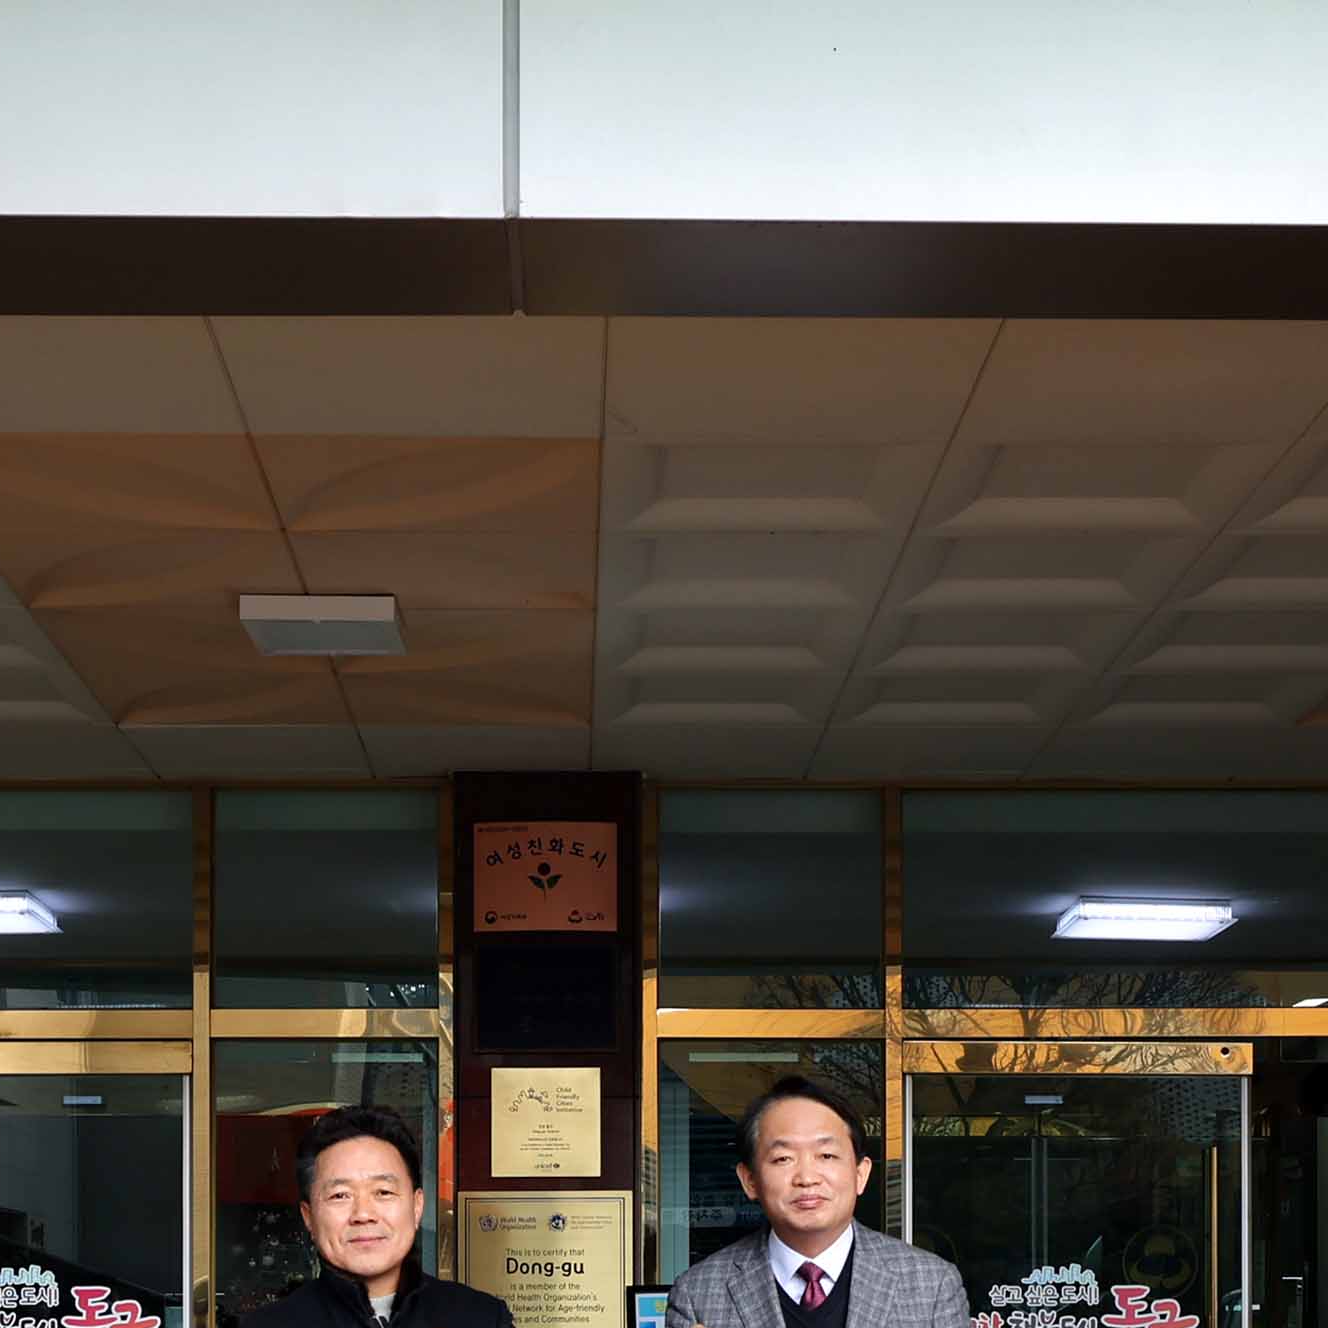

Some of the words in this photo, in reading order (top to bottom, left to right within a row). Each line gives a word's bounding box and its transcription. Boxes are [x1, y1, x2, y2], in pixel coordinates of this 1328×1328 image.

[486, 836, 608, 868] 여성친화도시
[505, 1257, 585, 1277] Dong-gu
[20, 1286, 59, 1308] 도시!
[989, 1285, 1024, 1307] 살고
[1025, 1285, 1060, 1307] 싶은
[1060, 1285, 1100, 1306] 도시!
